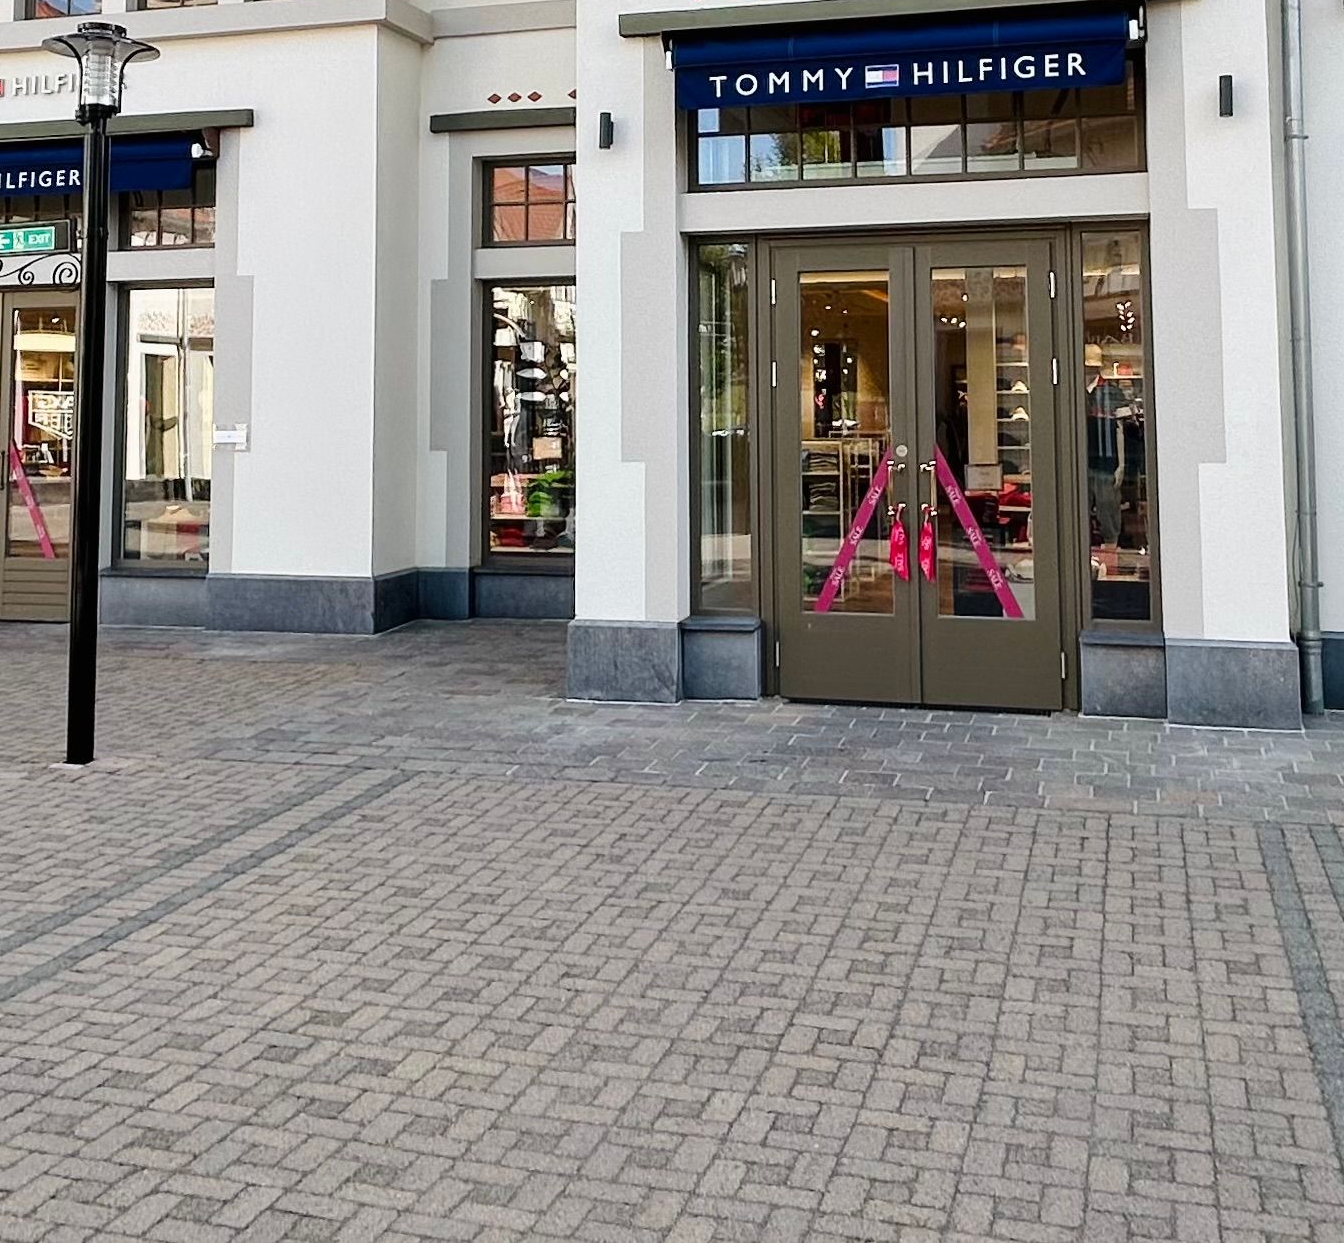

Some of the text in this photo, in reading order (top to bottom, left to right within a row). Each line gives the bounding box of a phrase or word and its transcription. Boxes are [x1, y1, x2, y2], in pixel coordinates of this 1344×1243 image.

[13, 72, 76, 97] HILFI
[709, 52, 1087, 97] TOMMY HILFIGER
[28, 233, 51, 244] EXIT
